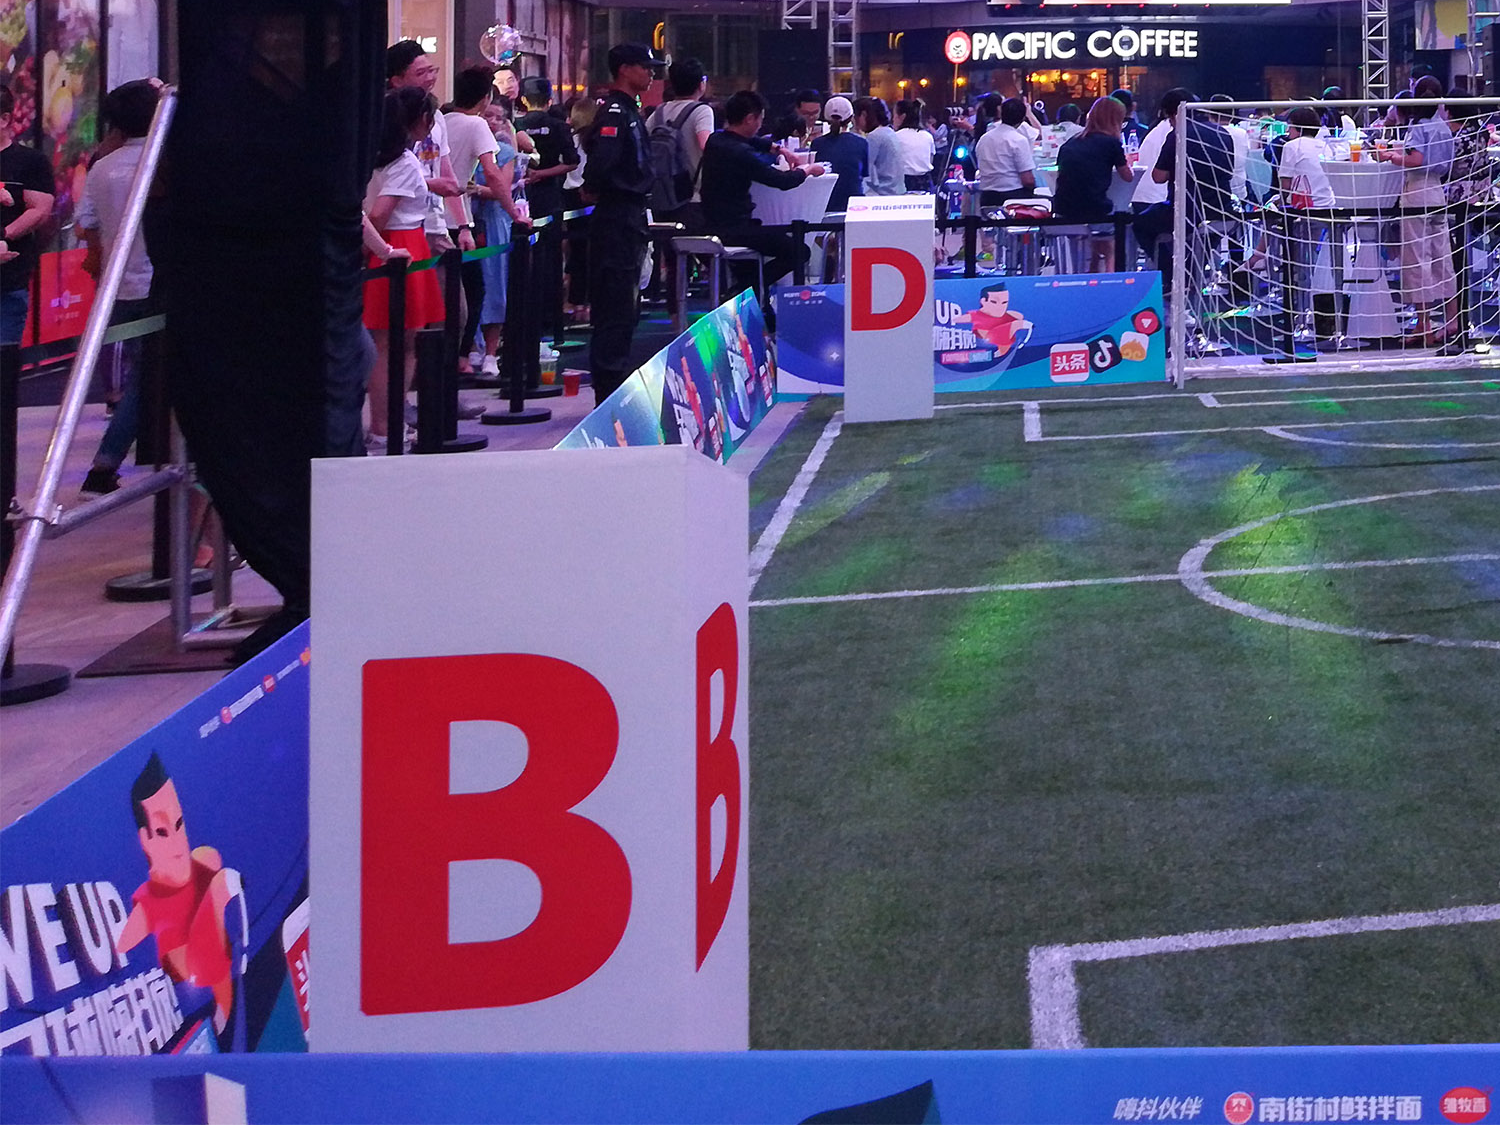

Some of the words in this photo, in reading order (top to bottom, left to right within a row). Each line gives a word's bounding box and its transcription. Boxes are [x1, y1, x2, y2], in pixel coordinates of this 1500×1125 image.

[971, 32, 1076, 60] PACIFIC
[1087, 29, 1198, 58] COFFEE
[851, 247, 926, 331] D
[935, 300, 962, 326] UP
[1054, 354, 1086, 372] 头条
[696, 602, 741, 972] B
[360, 653, 632, 1016] B
[65, 881, 130, 974] UP
[1113, 1095, 1203, 1120] 嗨抖伙伴
[1258, 1095, 1422, 1122] 南街村鲜拌面
